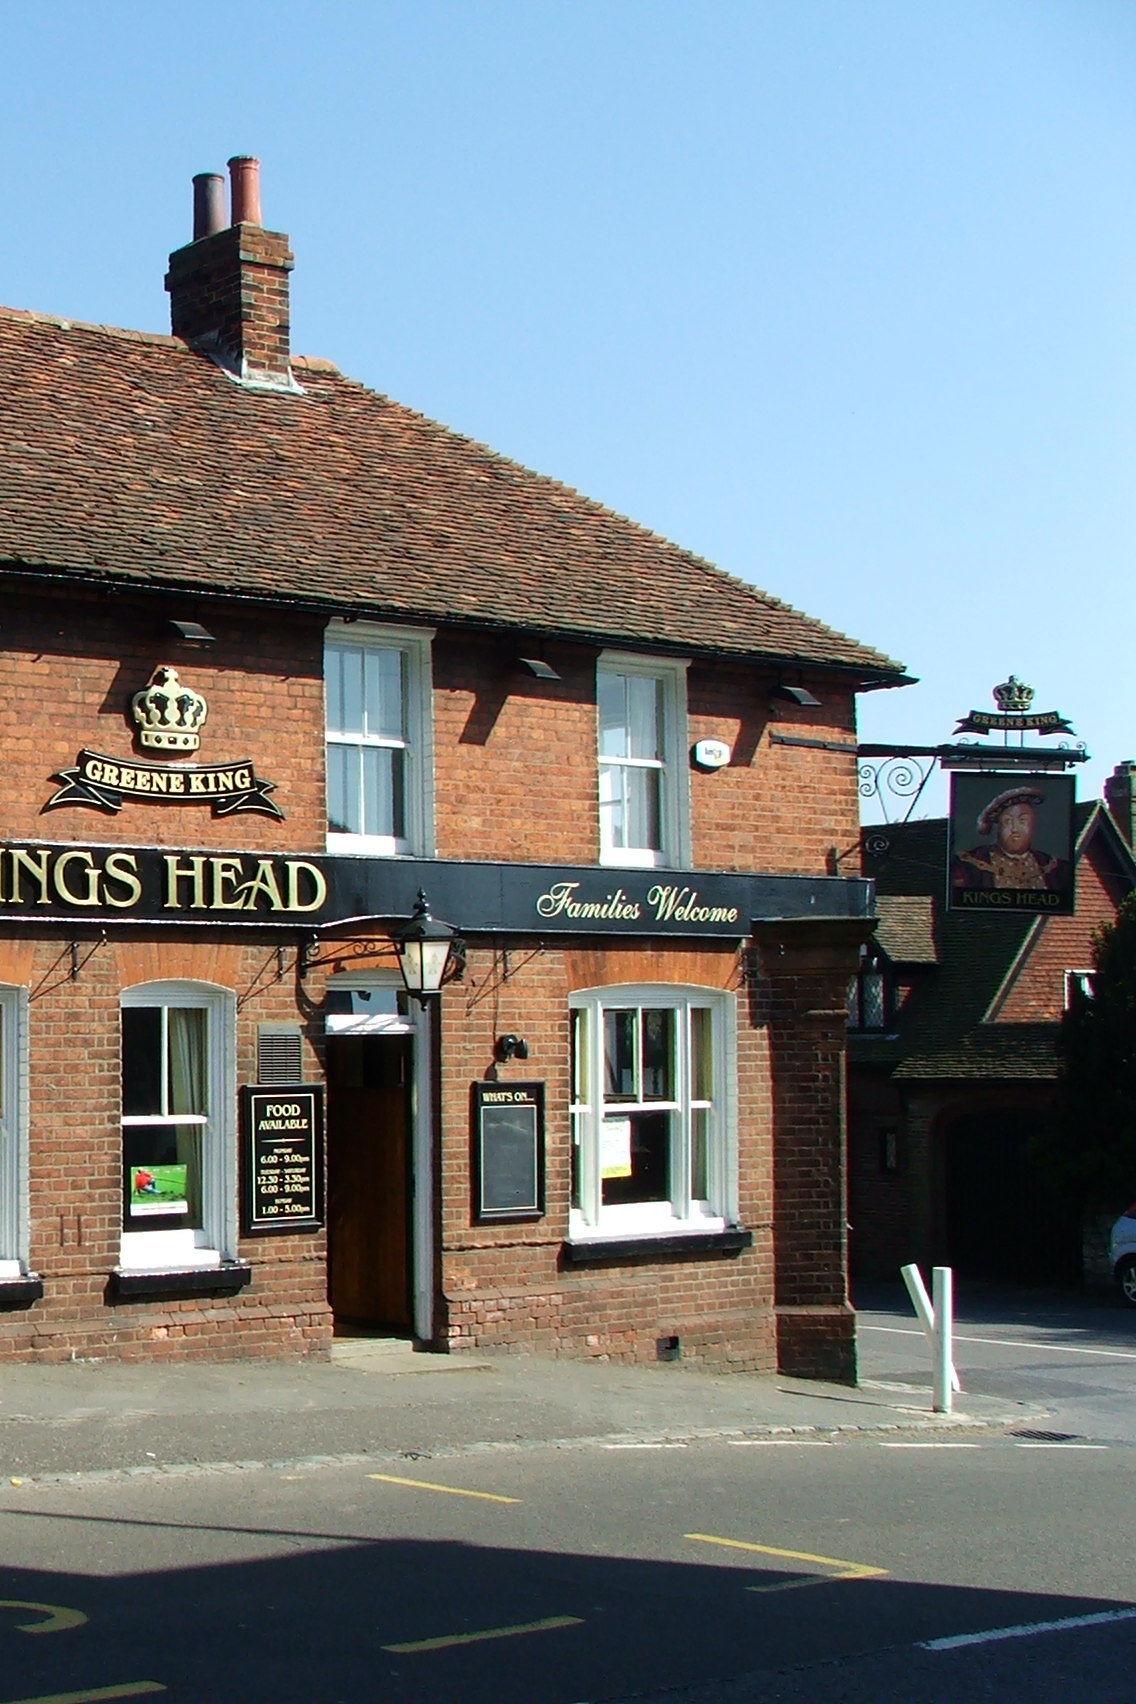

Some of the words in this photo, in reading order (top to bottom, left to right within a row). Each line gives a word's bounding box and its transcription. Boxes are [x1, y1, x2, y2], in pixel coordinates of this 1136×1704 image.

[1026, 715, 1058, 726] KING
[85, 759, 185, 793] GREENE
[189, 769, 252, 793] KING
[163, 855, 327, 912] HEAD
[536, 882, 640, 920] Families
[647, 885, 738, 923] Welcome
[963, 890, 1012, 906] KINGS
[1017, 892, 1060, 906] HEAD
[266, 1104, 301, 1117] FOOD
[258, 1118, 309, 1130] AVAILABLE
[260, 1155, 278, 1164] 6.00
[260, 1185, 278, 1194] 6.00
